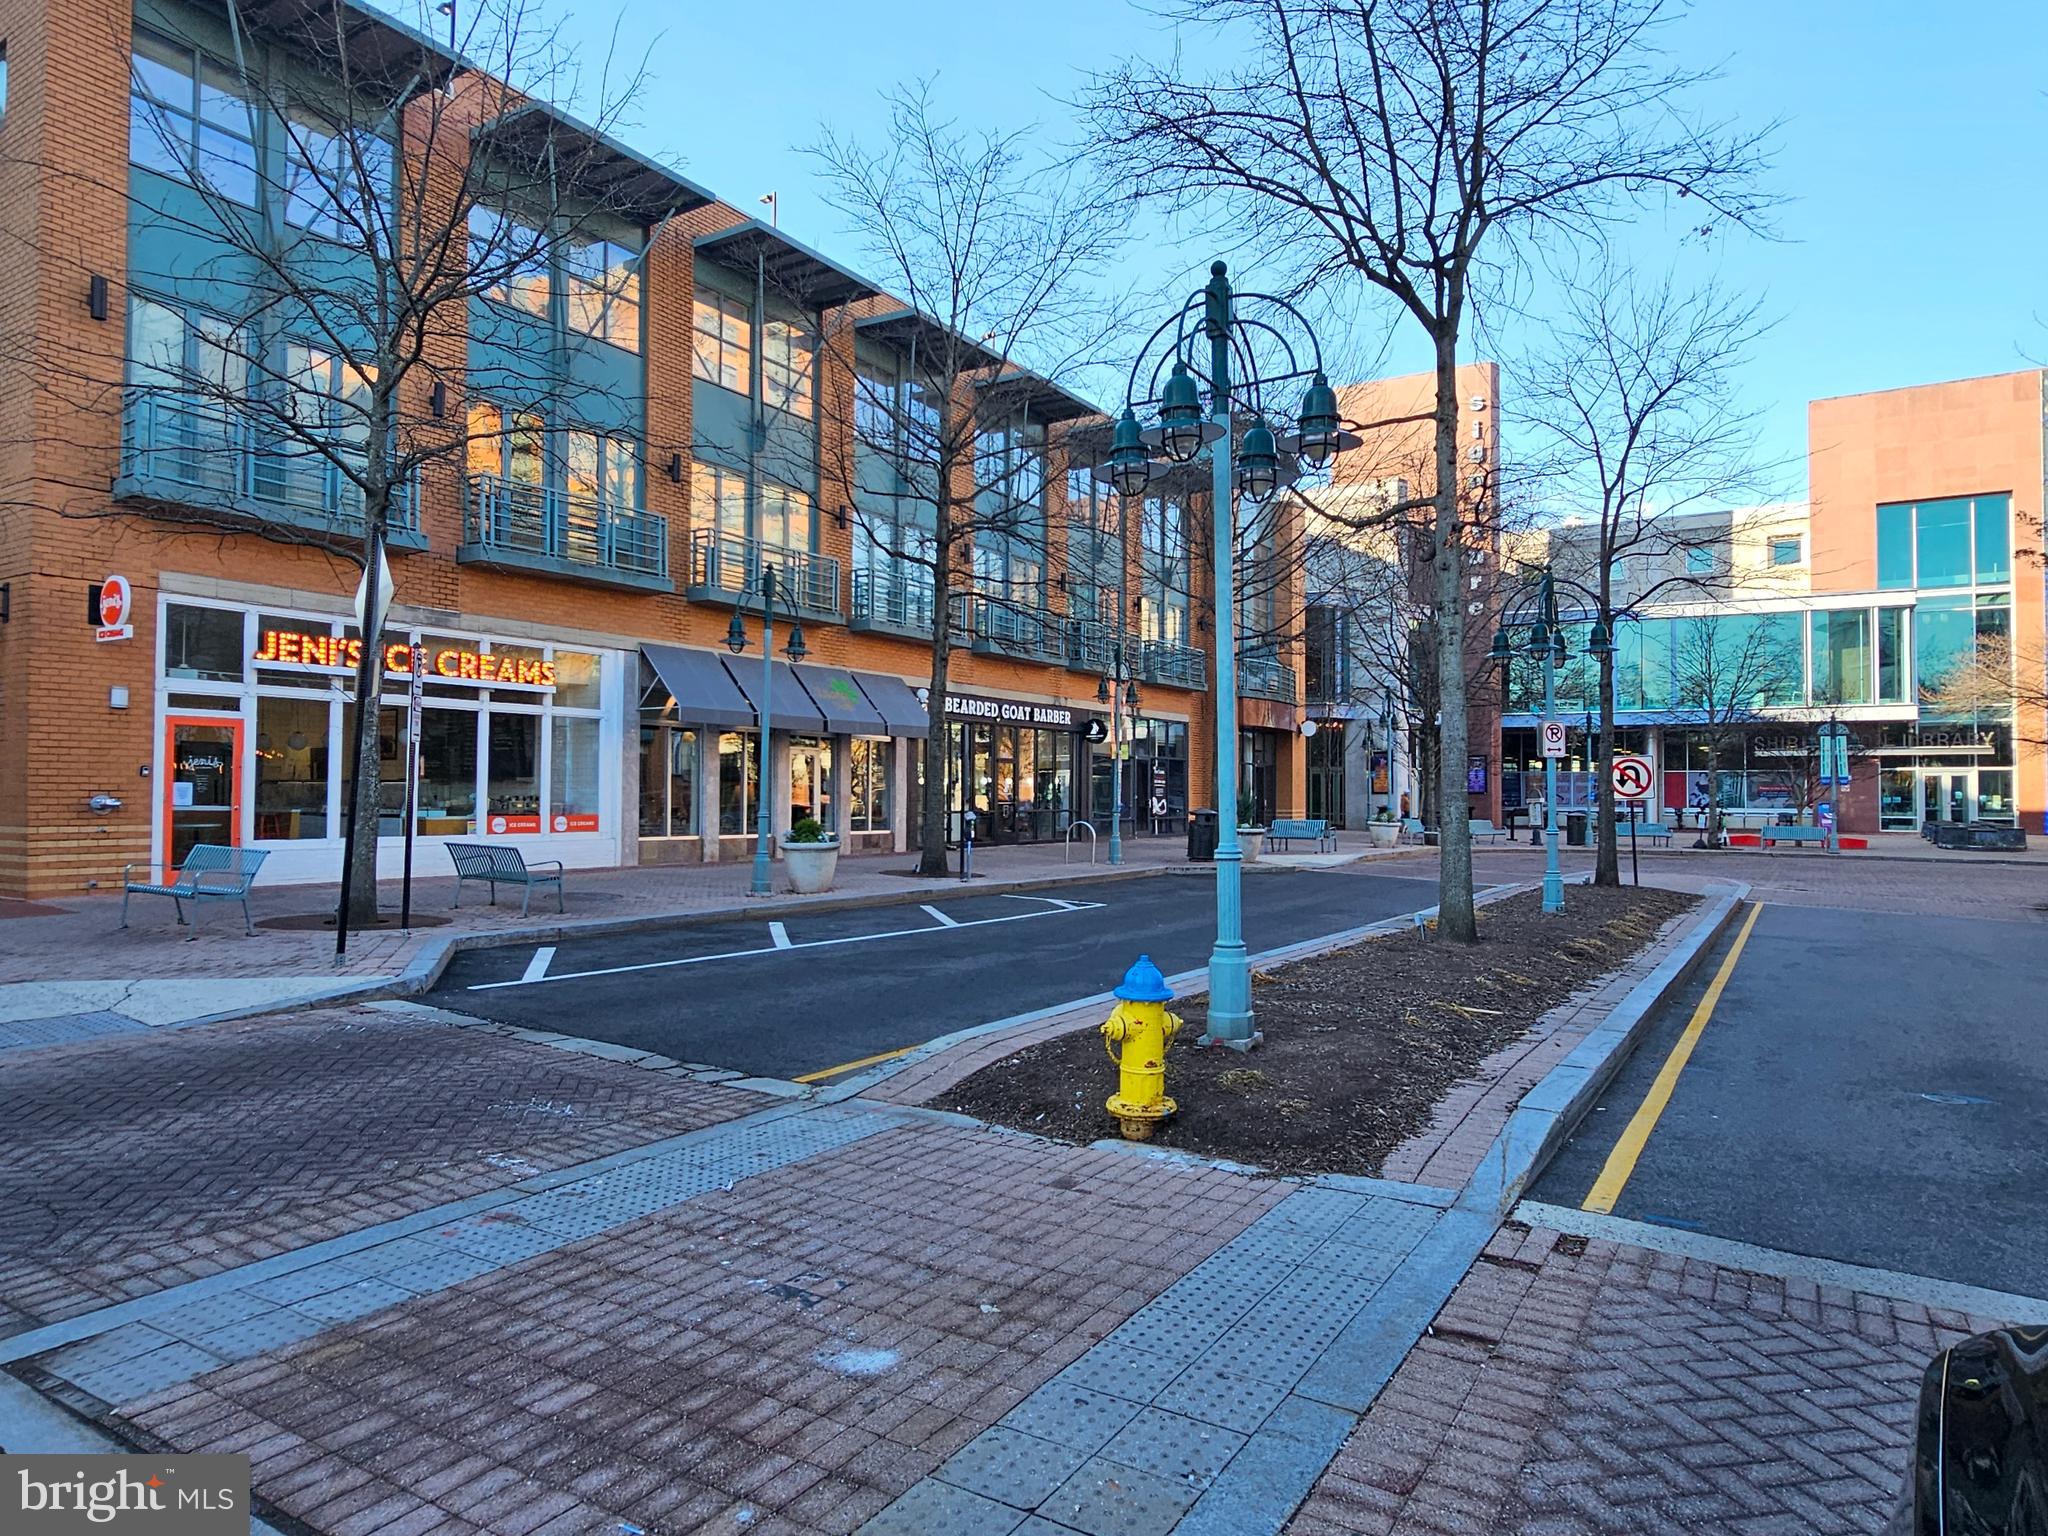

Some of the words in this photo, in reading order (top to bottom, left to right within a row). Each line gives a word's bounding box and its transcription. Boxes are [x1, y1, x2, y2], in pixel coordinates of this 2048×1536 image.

[254, 630, 362, 668] JENI'S
[434, 650, 557, 686] CREAMS
[945, 697, 999, 718] BEARDED
[1001, 704, 1031, 722] GOAT
[1033, 709, 1071, 725] BARBER
